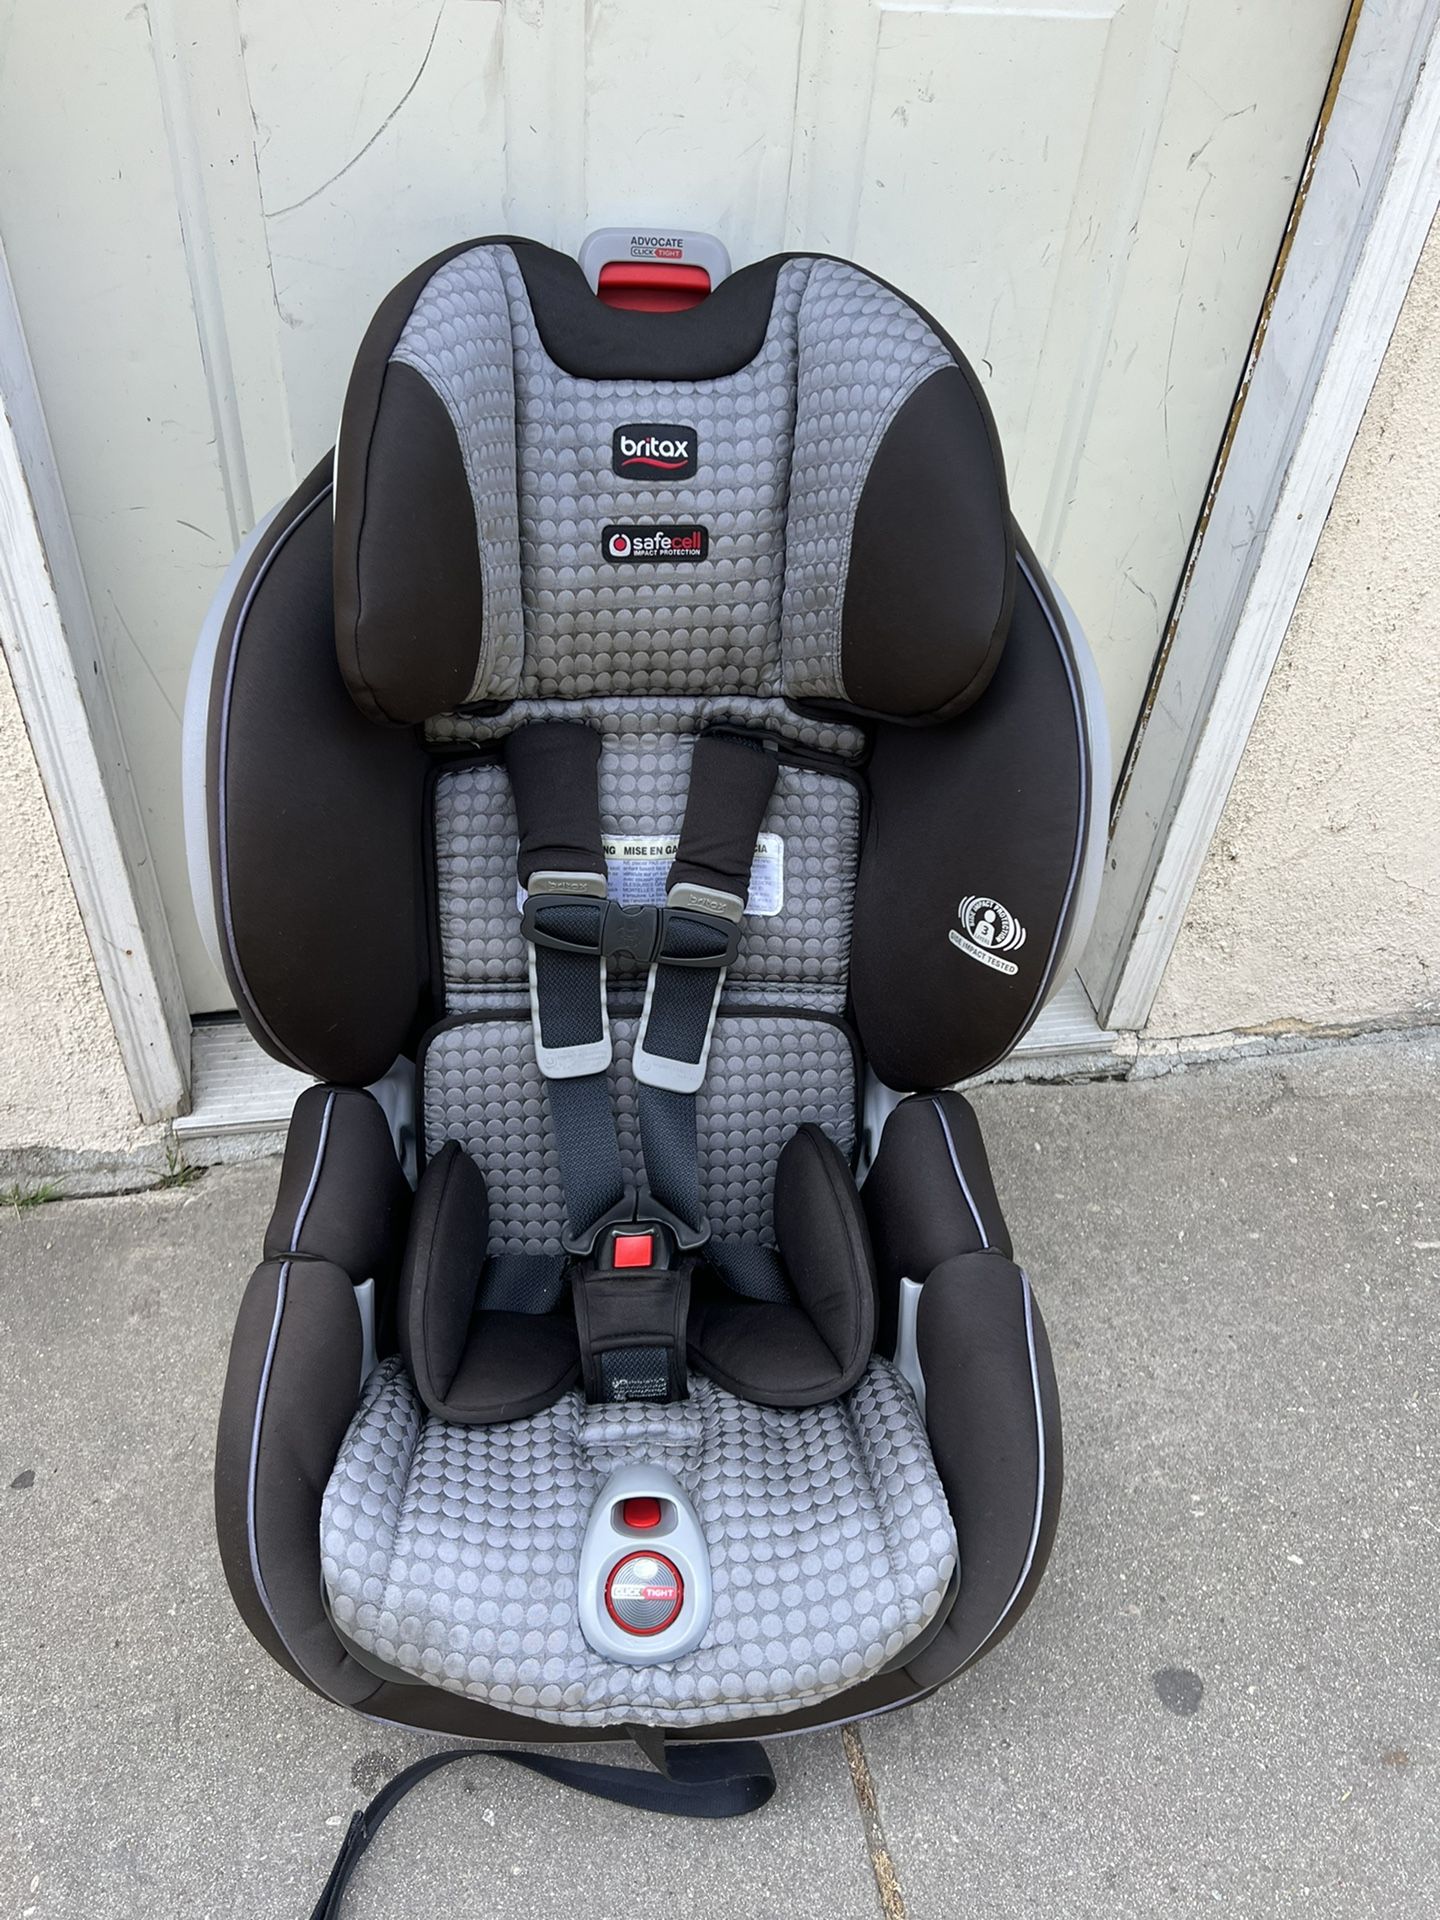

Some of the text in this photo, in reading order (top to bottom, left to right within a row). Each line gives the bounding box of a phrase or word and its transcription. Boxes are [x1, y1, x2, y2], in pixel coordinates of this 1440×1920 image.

[630, 236, 684, 248] ADVOCATE
[620, 436, 689, 458] britax
[632, 531, 701, 549] safecell
[623, 846, 648, 855] MISE
[649, 846, 663, 855] EN
[980, 925, 990, 936] 3
[987, 956, 1016, 973] TESTED
[646, 1588, 674, 1597] TIGHT
